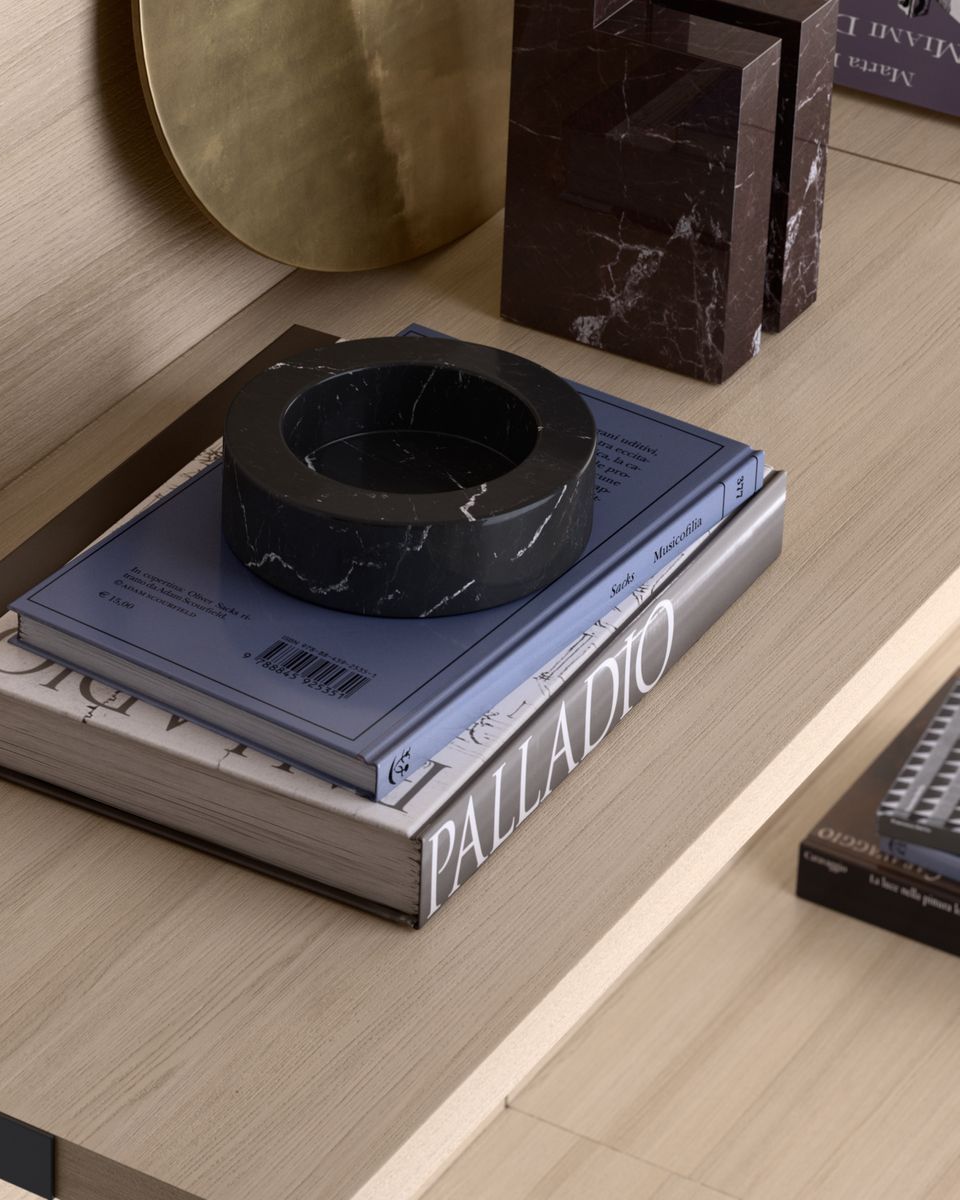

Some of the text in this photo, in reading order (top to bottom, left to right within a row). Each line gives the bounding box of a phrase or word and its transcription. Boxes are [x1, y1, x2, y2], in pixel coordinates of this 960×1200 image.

[868, 21, 960, 64] MIAMI
[848, 55, 916, 87] Marta
[610, 517, 703, 598] Sacks Musicofilia
[156, 587, 184, 601] Adam
[215, 602, 239, 616] Sacks
[427, 599, 675, 919] PALLADIO
